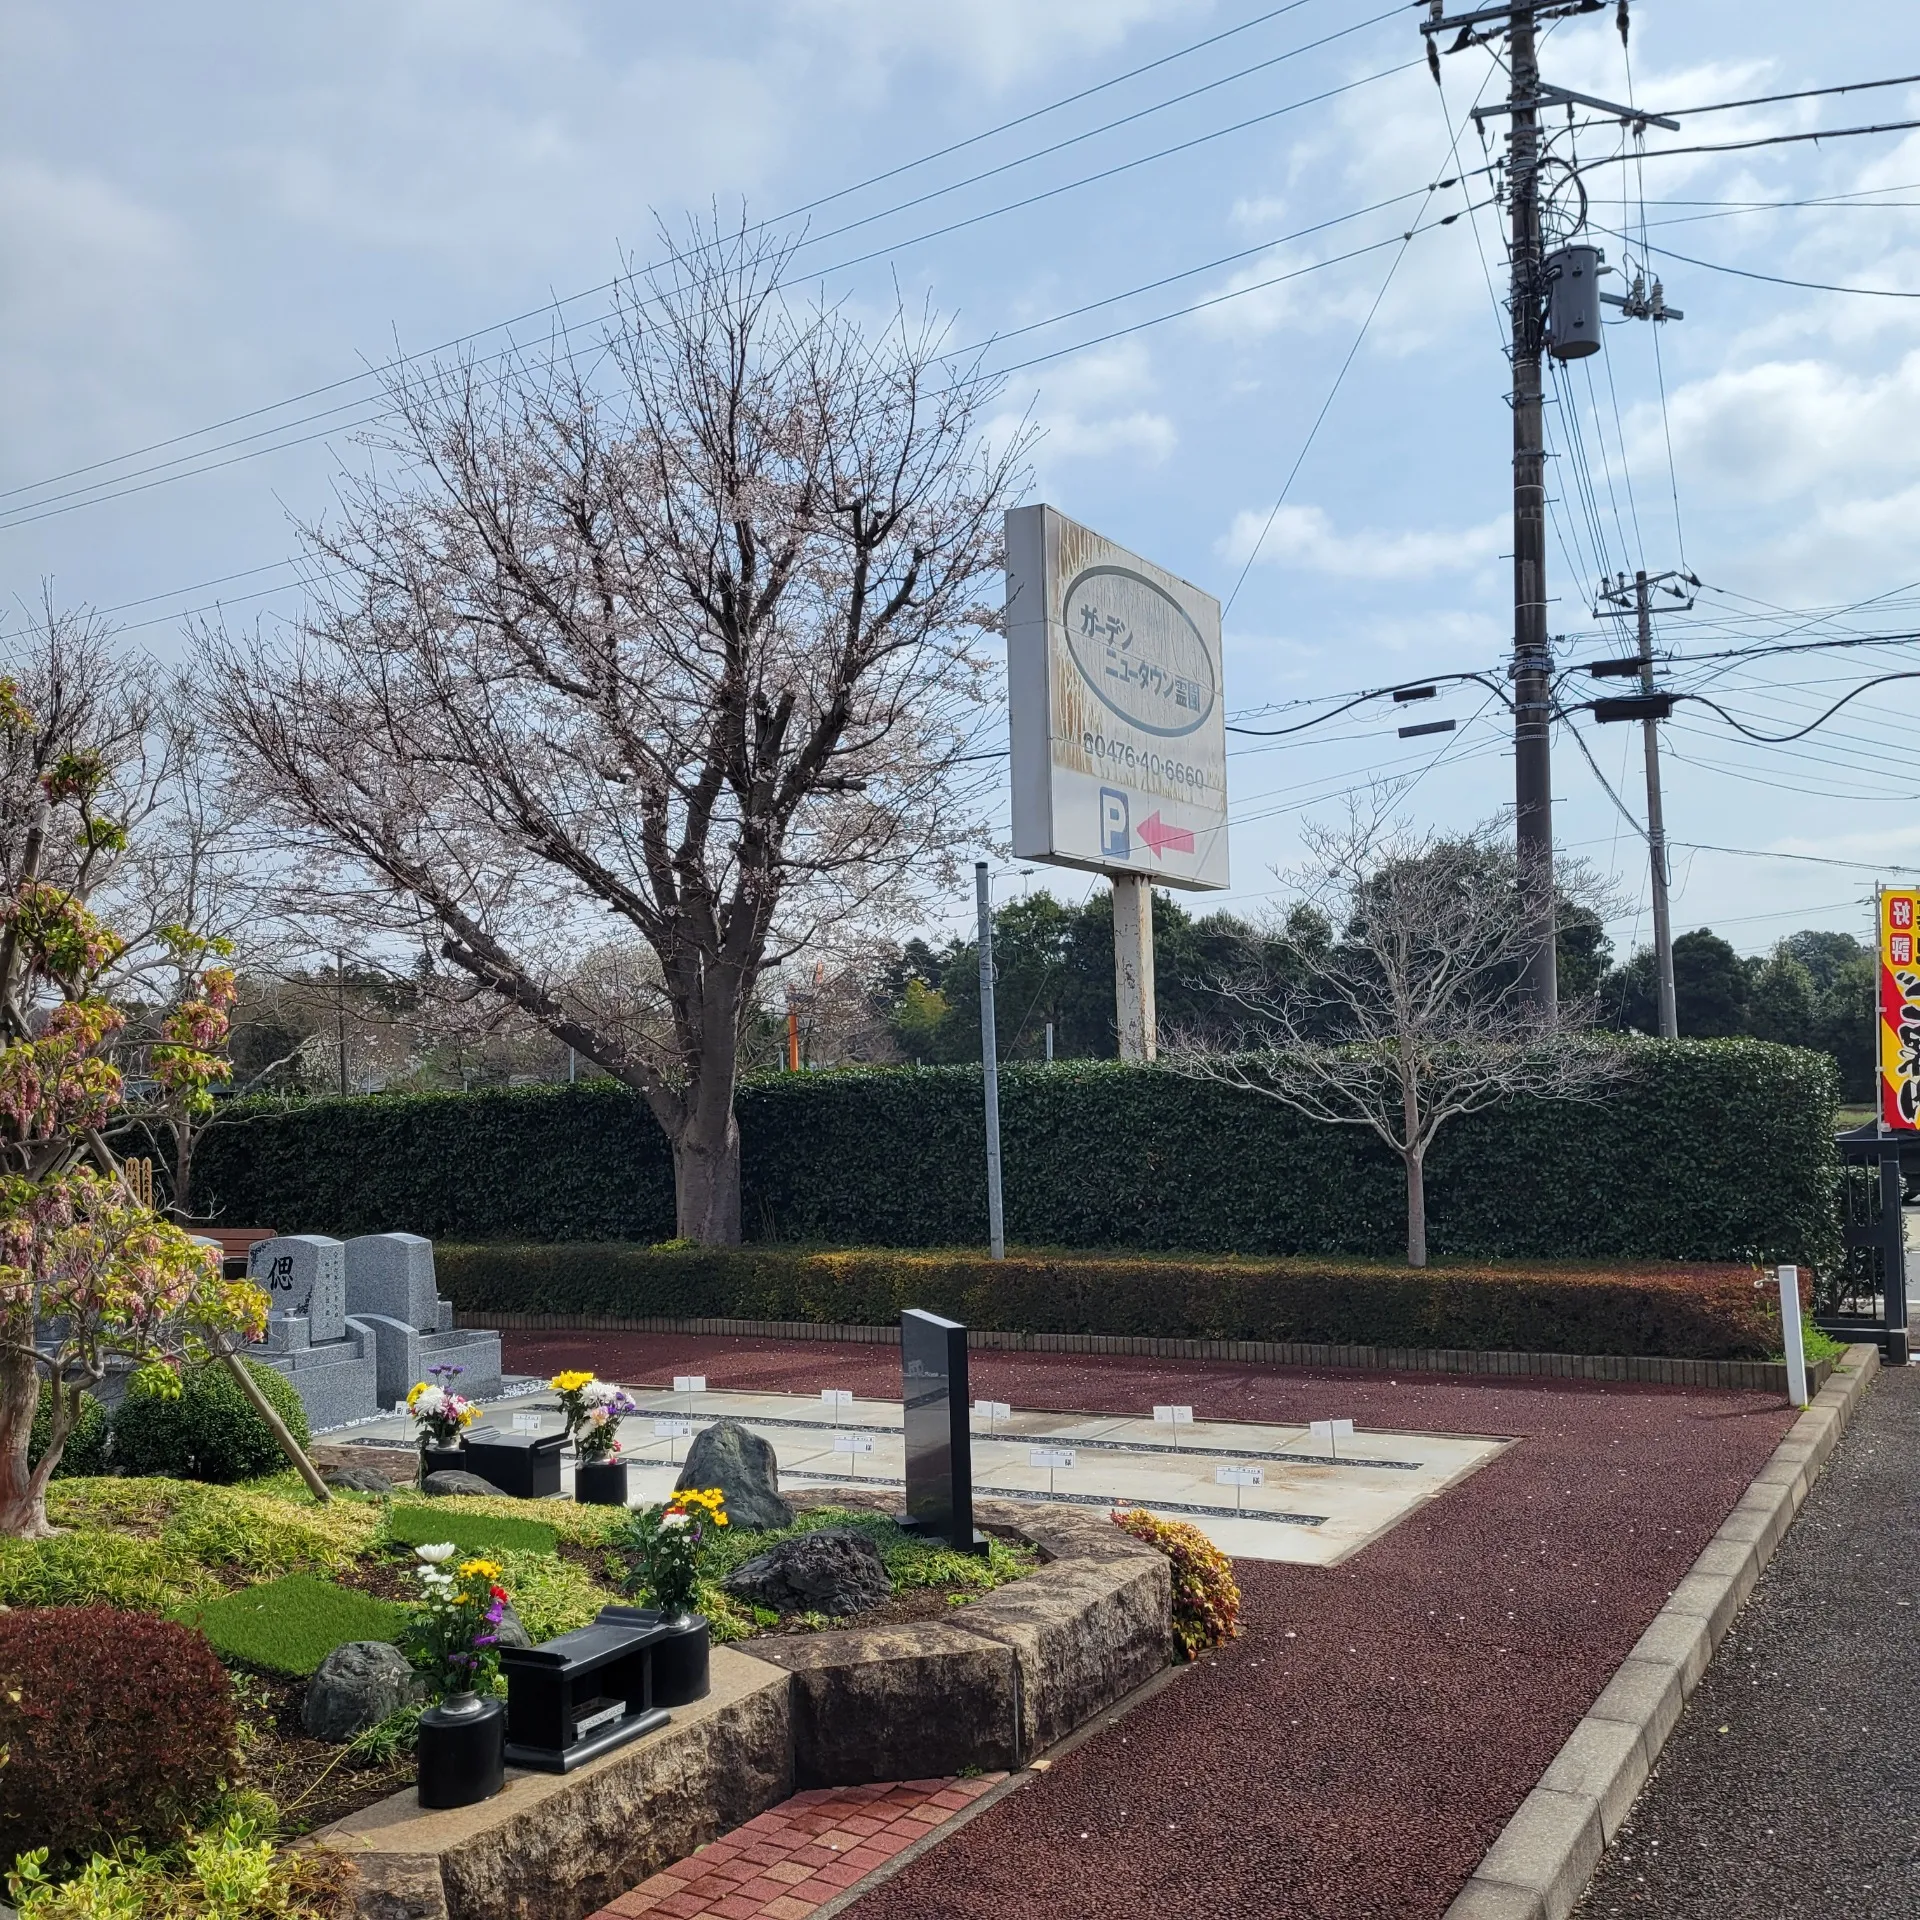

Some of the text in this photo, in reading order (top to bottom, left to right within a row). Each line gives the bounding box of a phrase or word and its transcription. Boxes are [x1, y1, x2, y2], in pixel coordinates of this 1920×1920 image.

[1080, 604, 1133, 650] ガーデン
[1102, 794, 1127, 850] P
[267, 1256, 294, 1291] 偲
